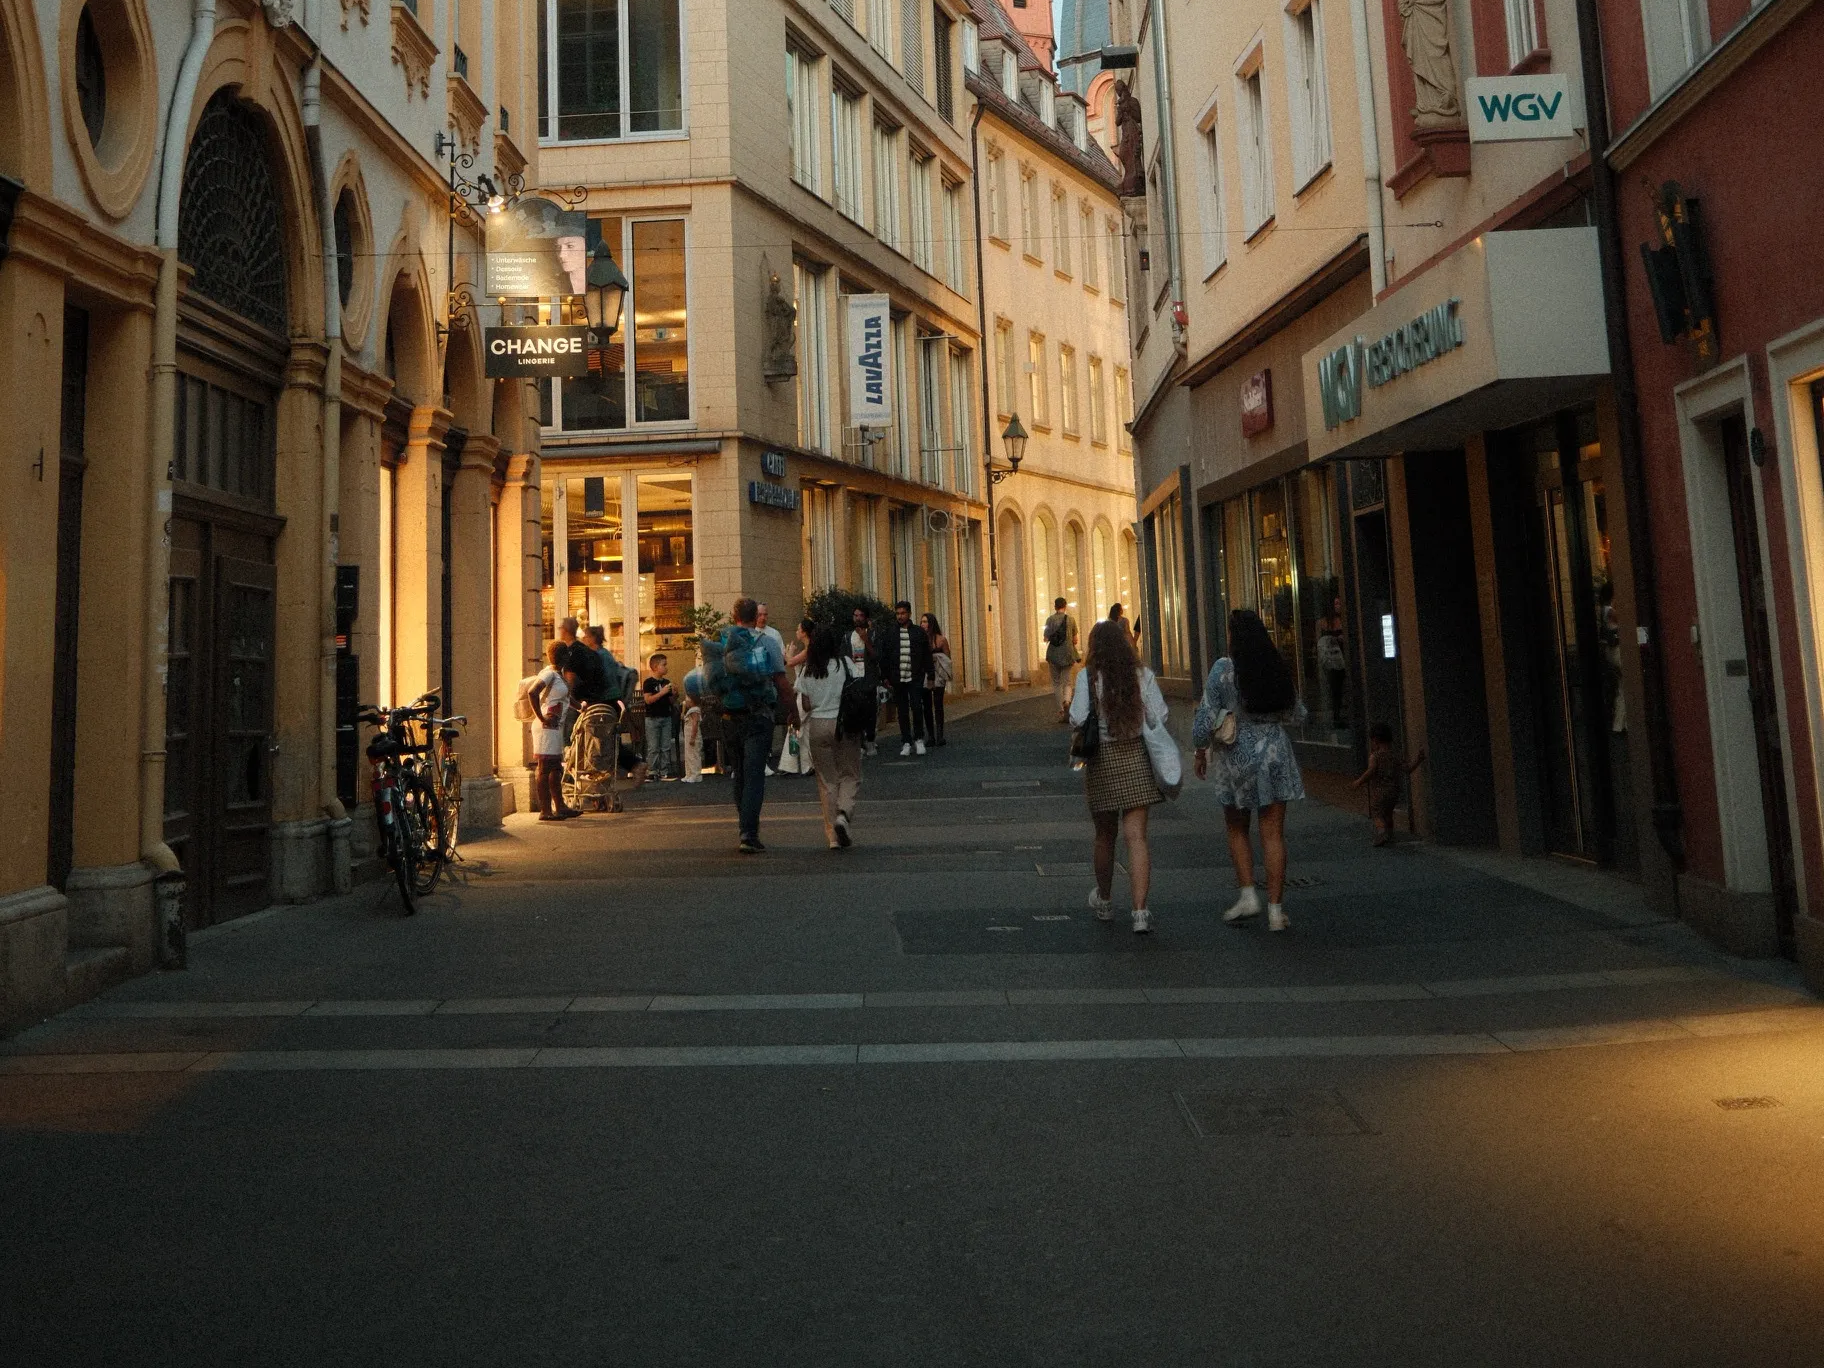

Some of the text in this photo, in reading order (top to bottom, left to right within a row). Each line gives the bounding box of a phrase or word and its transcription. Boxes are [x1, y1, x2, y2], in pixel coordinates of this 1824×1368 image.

[1478, 91, 1562, 123] WGV
[490, 337, 583, 355] CHANGE
[858, 315, 883, 405] LAVAZZA
[1318, 335, 1363, 431] WGV
